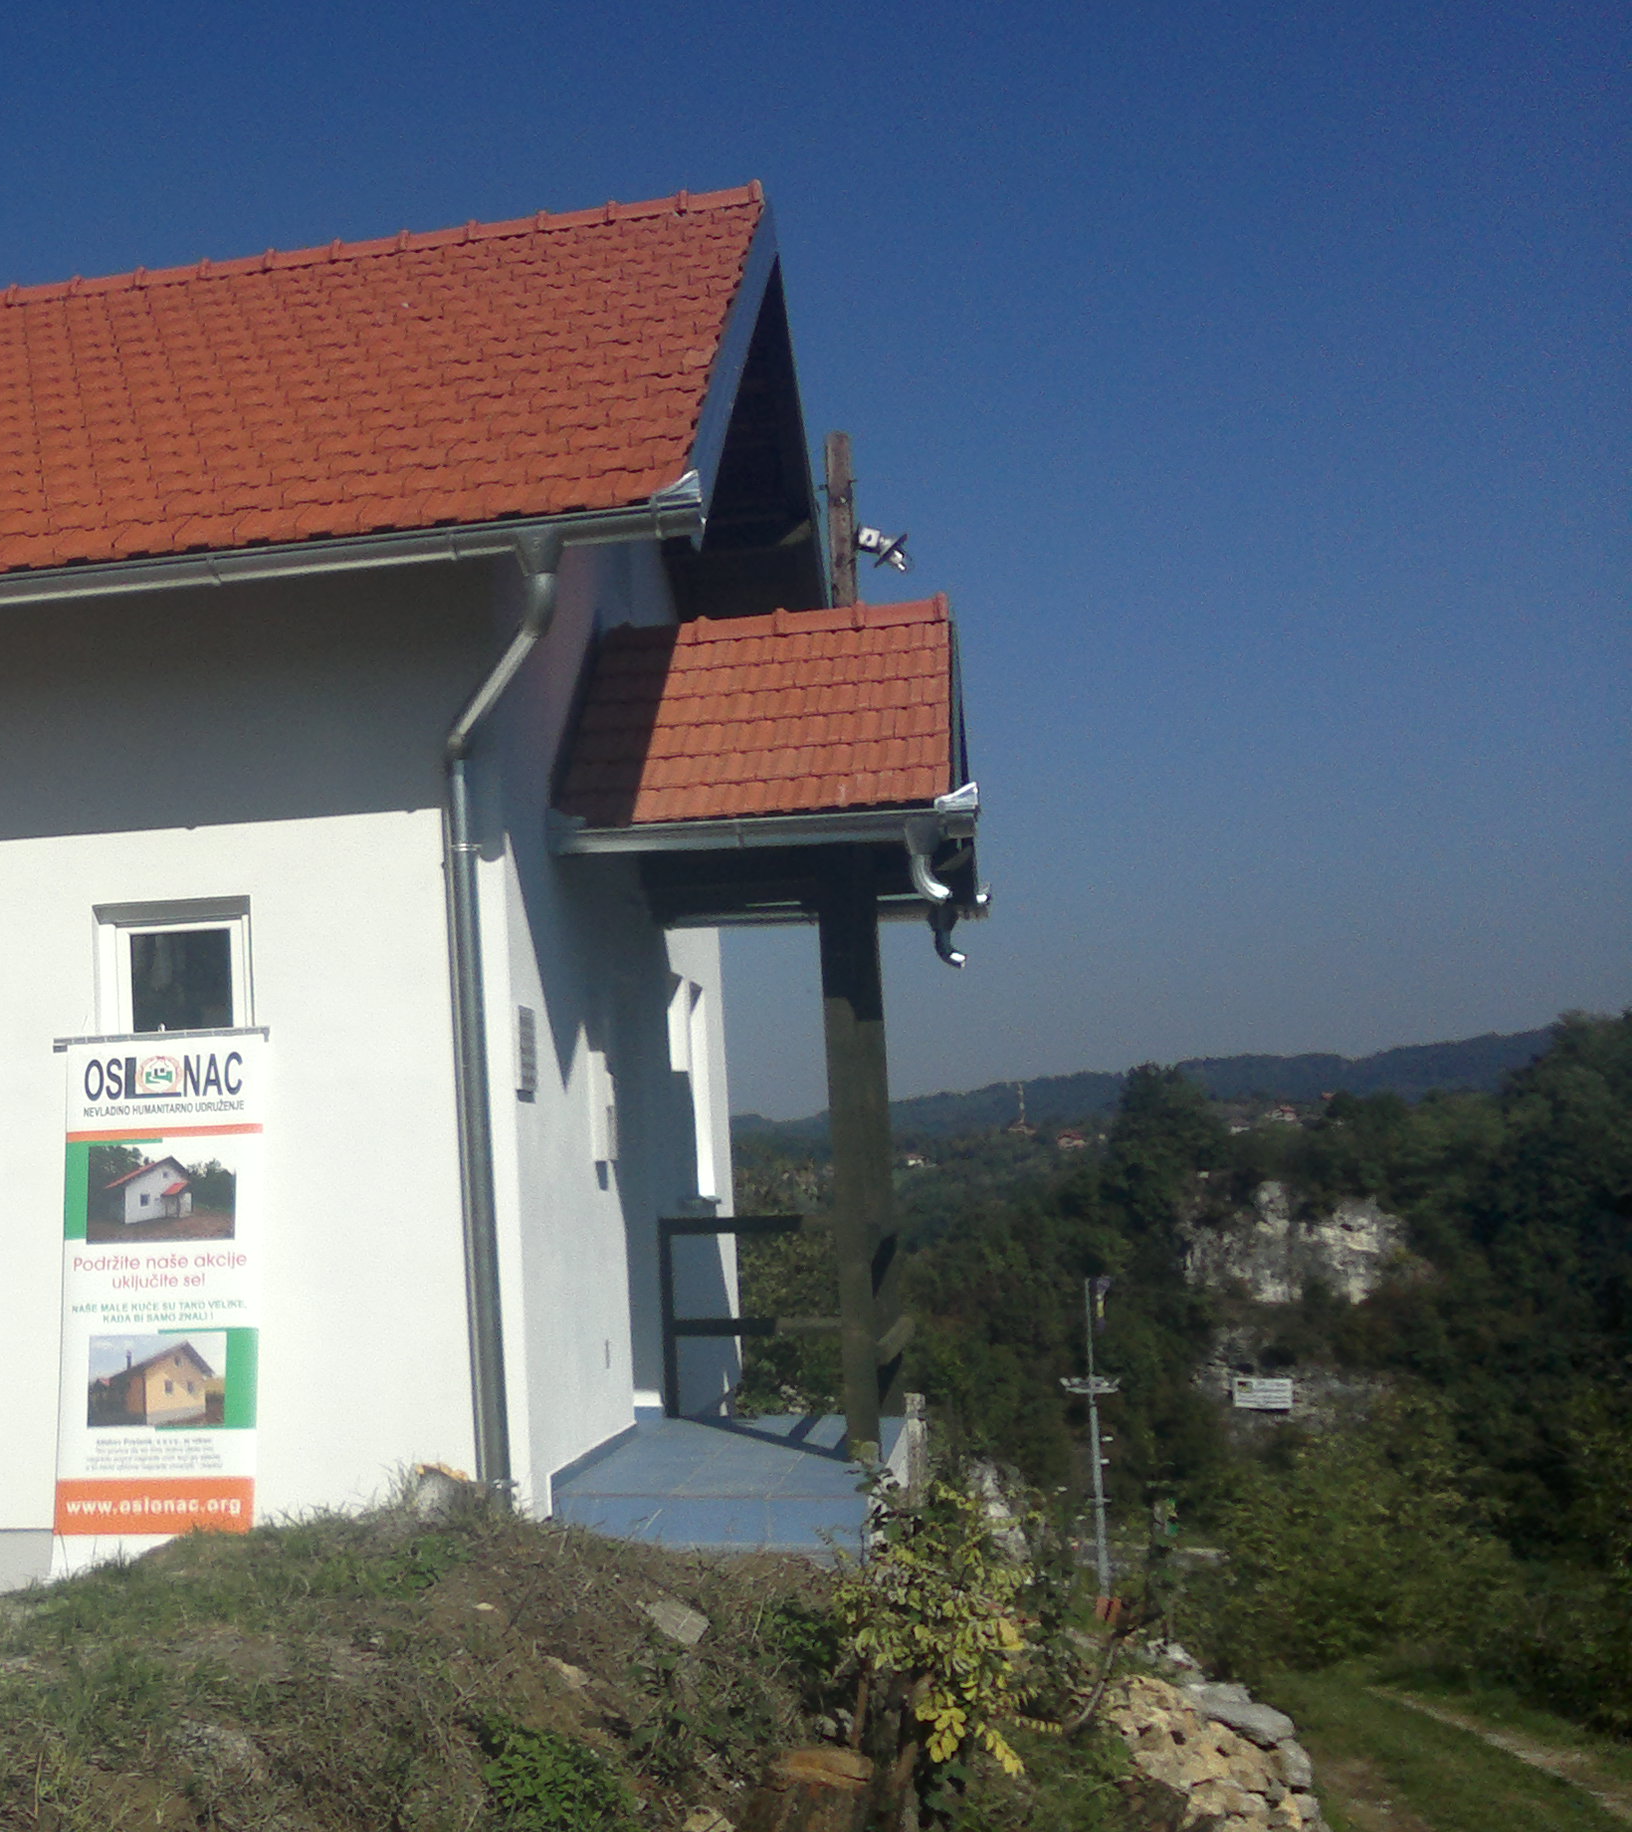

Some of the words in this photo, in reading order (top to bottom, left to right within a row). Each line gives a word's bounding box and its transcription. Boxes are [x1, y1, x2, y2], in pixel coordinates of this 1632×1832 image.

[83, 1105, 131, 1118] NEVLADINO
[132, 1102, 193, 1116] HUMANITARNO
[195, 1100, 245, 1113] UDRUŽENJE
[73, 1255, 141, 1272] Podržite
[146, 1253, 189, 1270] naše
[194, 1252, 247, 1269] akcije
[112, 1274, 179, 1291] uključite
[101, 1302, 128, 1313] MALE
[162, 1302, 176, 1311] SU
[66, 1496, 242, 1516] www.oslonac.org
